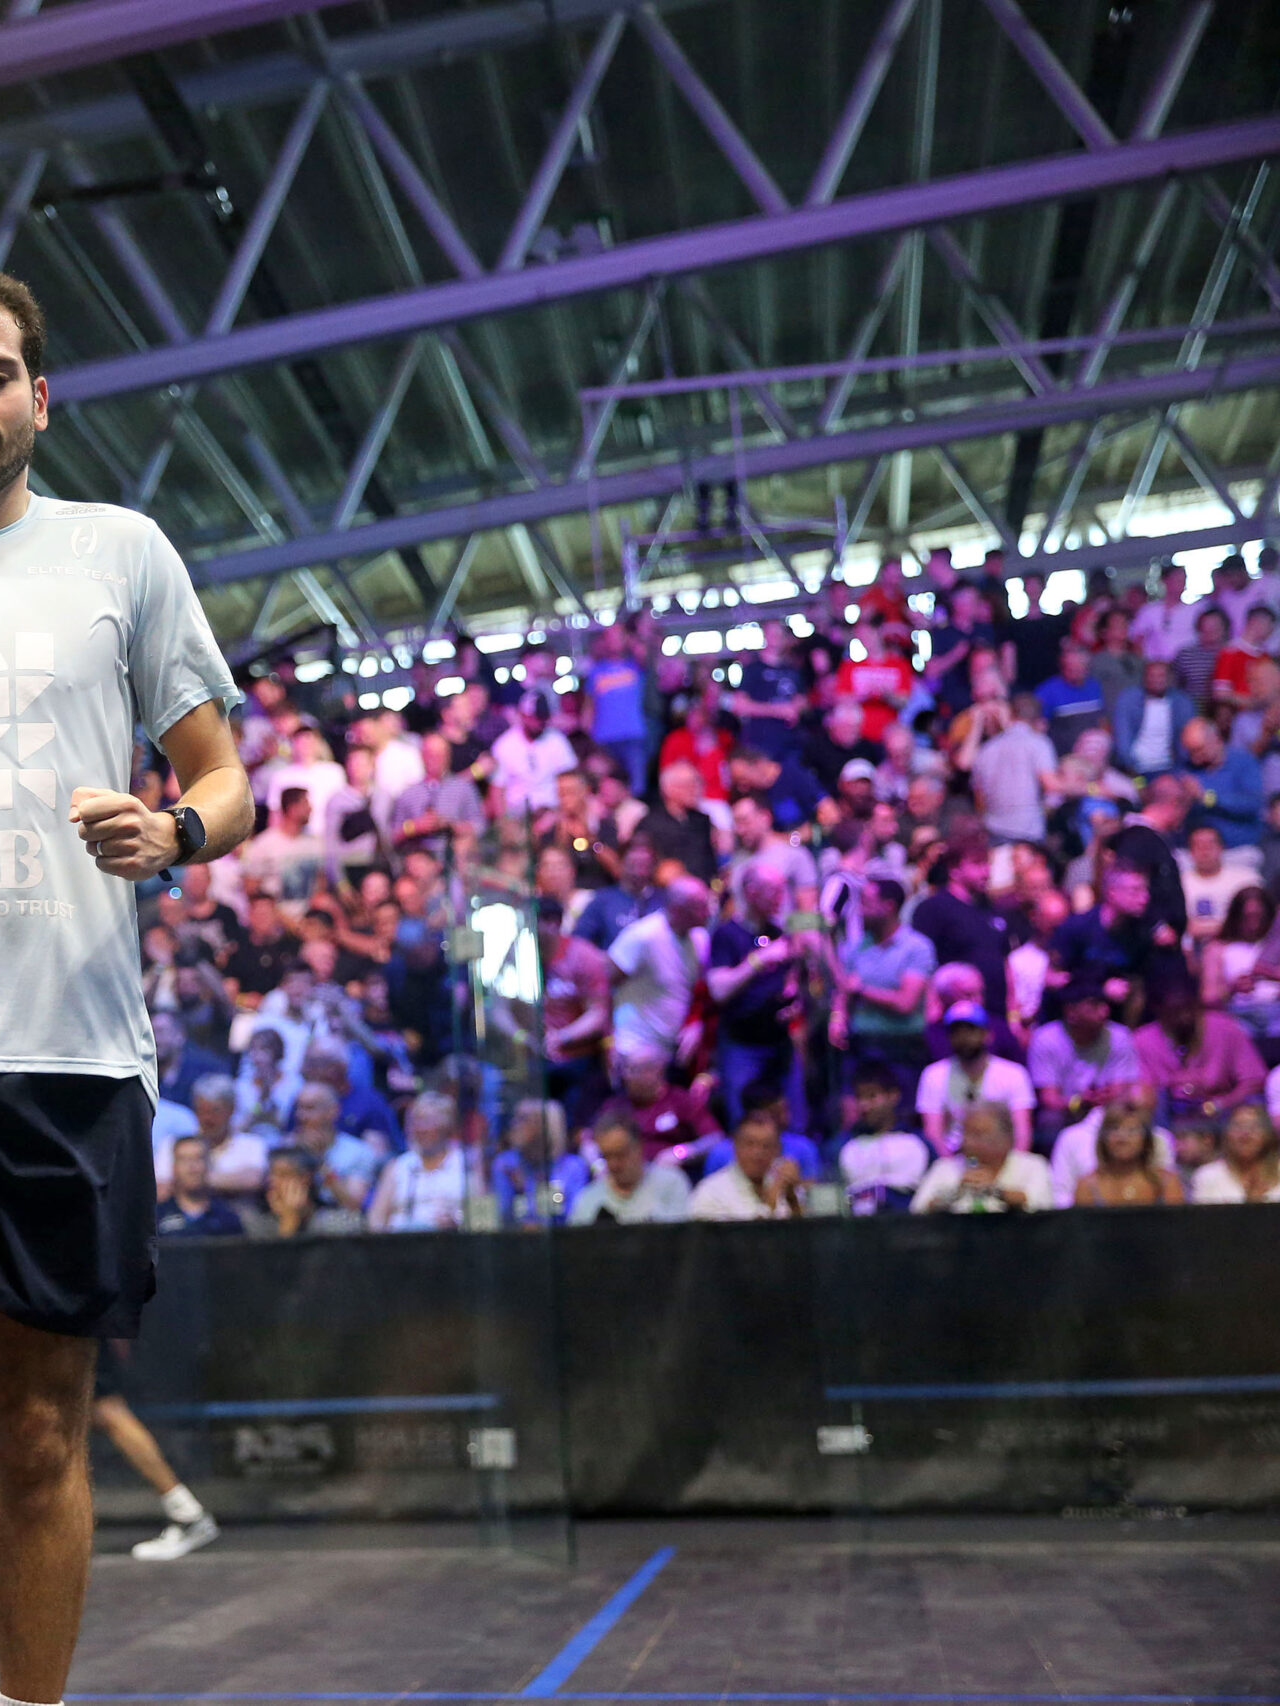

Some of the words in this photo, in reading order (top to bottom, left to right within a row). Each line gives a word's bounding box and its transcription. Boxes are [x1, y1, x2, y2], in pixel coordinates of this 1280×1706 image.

[26, 566, 74, 576] ELITE
[81, 567, 128, 586] TEAM
[16, 899, 77, 920] TRUST
